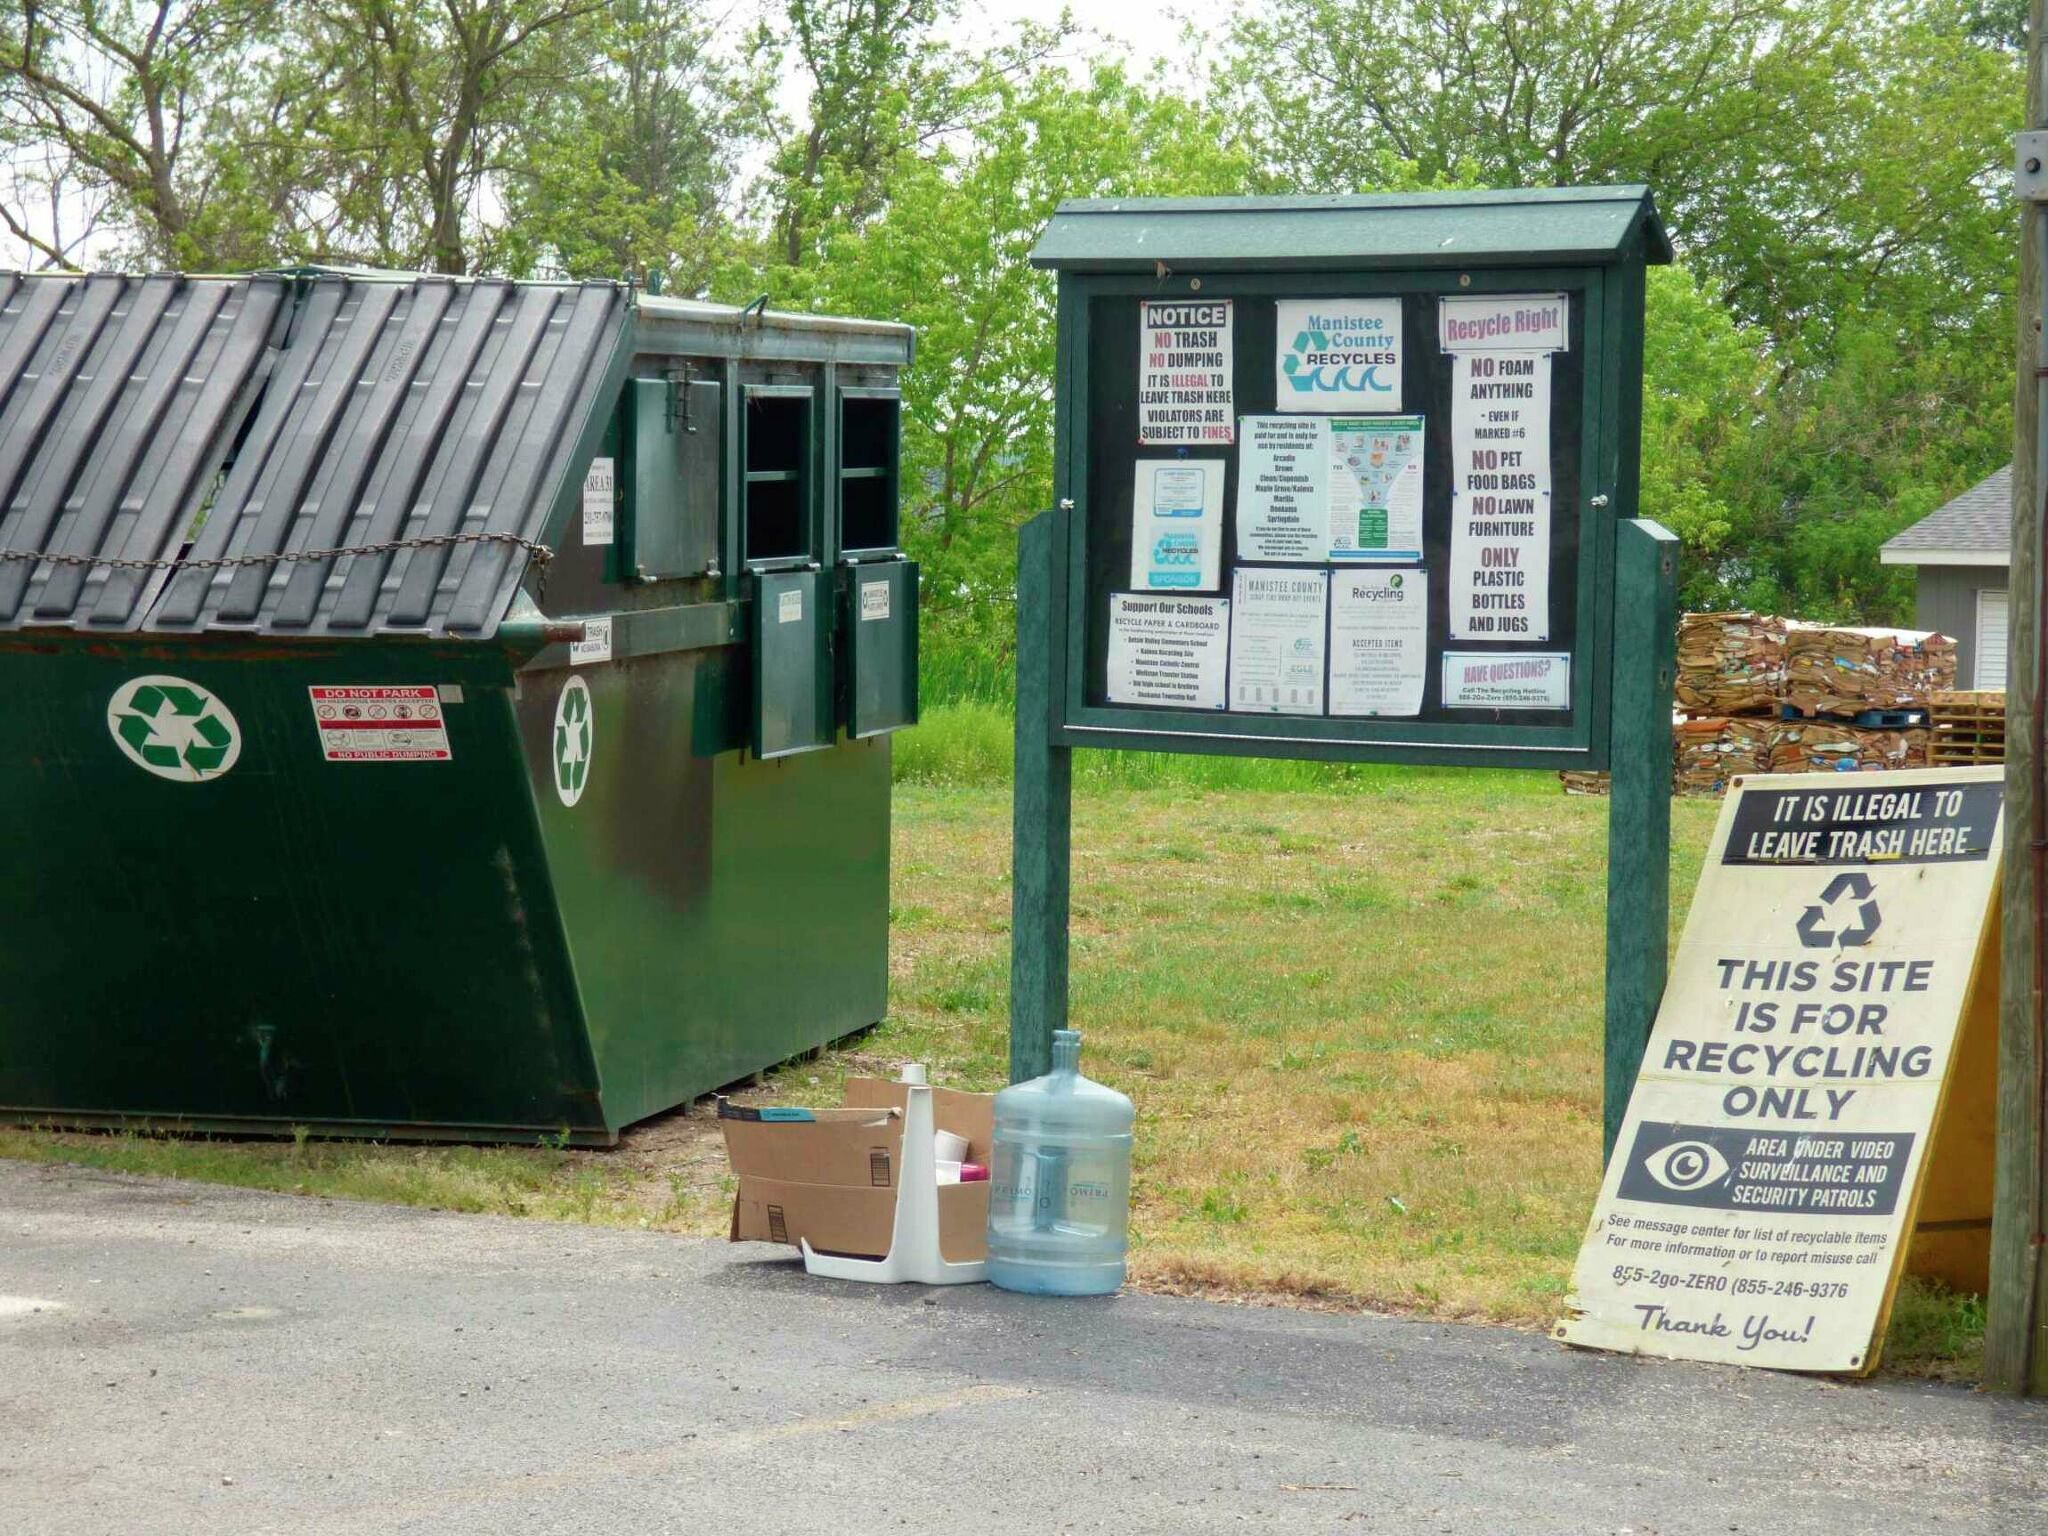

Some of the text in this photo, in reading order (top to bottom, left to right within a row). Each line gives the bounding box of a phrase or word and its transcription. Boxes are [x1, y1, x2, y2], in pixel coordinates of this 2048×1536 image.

[1149, 306, 1225, 326] NOTICE
[1307, 315, 1383, 331] Manistee
[1447, 307, 1559, 341] Recycle Right
[1154, 331, 1218, 349] NO TRASH
[1332, 333, 1394, 350] County
[1149, 352, 1223, 368] NO DUMPING
[1306, 353, 1396, 365] RECYCLES
[1470, 358, 1534, 378] NO FOAM
[1148, 374, 1224, 387] IT IS ILLEGAL TO
[1140, 390, 1232, 404] LEAVE TRASH HERE
[1470, 382, 1533, 400] ANYTHING
[1148, 409, 1224, 422] VIOLATORS ARE
[1488, 410, 1520, 422] EVEN IF
[1142, 426, 1232, 439] SUBJECT TO FINES
[1474, 427, 1526, 440] MARKED #6
[1472, 450, 1523, 471] NO PET
[1467, 474, 1536, 490] FOOD BAGS
[1472, 496, 1534, 516] NO LAWN
[1468, 521, 1535, 537] FURNITURE
[1481, 547, 1520, 568] ONLY
[1248, 580, 1289, 593] MANISTEE
[1291, 581, 1324, 594] COUNTY
[1473, 571, 1525, 587] PLASTIC
[1352, 587, 1404, 601] Recycling
[1472, 593, 1525, 610] BOTTLES
[1121, 600, 1214, 616] Support Our Schools
[1144, 619, 1165, 627] PAPER
[1174, 621, 1220, 630] CARDBOARD
[1469, 616, 1529, 633] AND JUGS
[1464, 659, 1551, 684] HAVE QUESTIONS?
[324, 689, 420, 698] DO NOT PARK
[338, 751, 438, 759] NO PUBLIC DUMPING
[1773, 790, 1963, 823] IT IS ILLEGAL TO
[1747, 826, 1972, 859] LEAVE TRASH HERE
[1717, 958, 1935, 993] THIS SITE
[1734, 1001, 1888, 1036] IS FOR
[1663, 1039, 1934, 1079] RECYCLING
[1722, 1085, 1857, 1121] ONLY
[1745, 1137, 1895, 1160] AREA UNDER VIDEO
[1739, 1161, 1888, 1184] SURVEILLANCE AND
[1732, 1185, 1878, 1208] SECURITY PATROLS
[1608, 1214, 1888, 1246] See message center for list of recyclable items
[1606, 1233, 1878, 1265] For more information or to report misuse call
[1612, 1264, 1849, 1298] 855-2go-ZERO (855-246-9376
[1634, 1304, 1816, 1351] Thank You!
